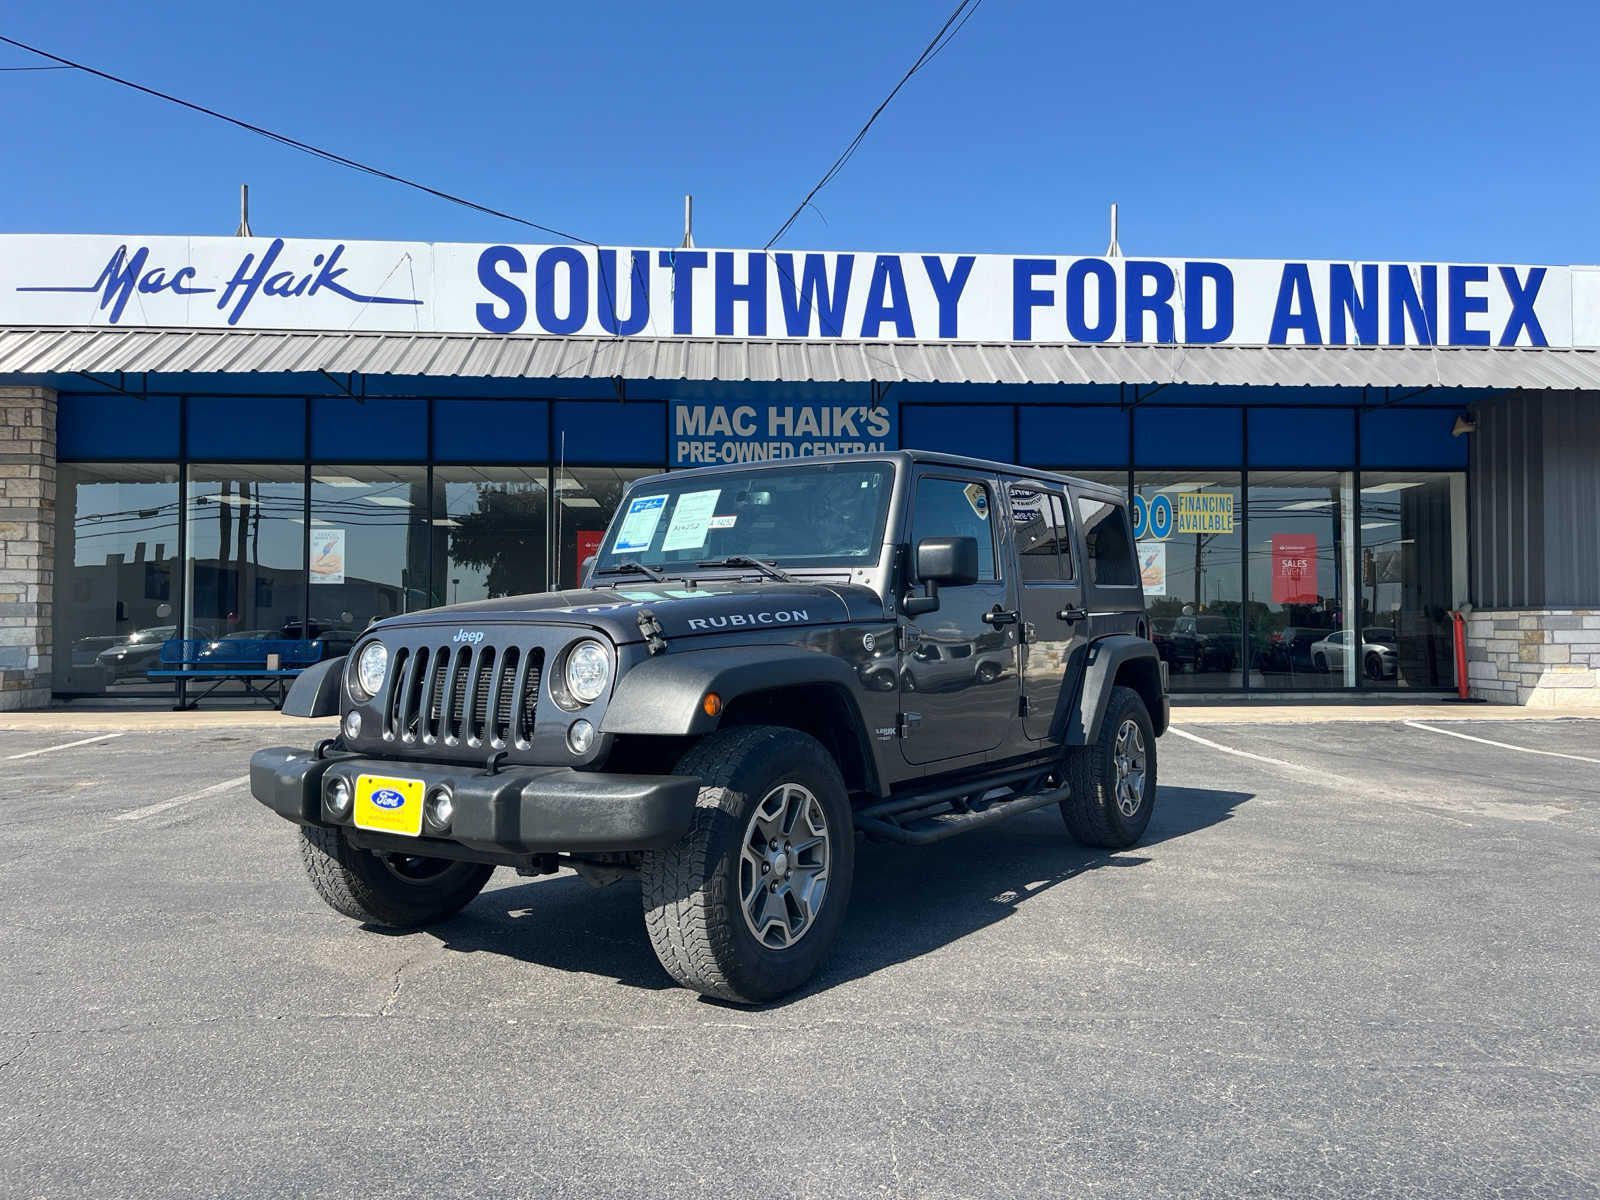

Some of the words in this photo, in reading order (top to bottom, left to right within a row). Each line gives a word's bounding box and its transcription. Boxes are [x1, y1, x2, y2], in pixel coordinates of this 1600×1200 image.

[16, 244, 216, 324] Mac
[217, 238, 424, 326] Haik
[476, 245, 977, 340] SOUTHWAY
[1013, 257, 1235, 344] FORD
[1268, 263, 1550, 347] ANNEX
[676, 405, 757, 437] MAC
[768, 406, 891, 438] HAIK'S
[677, 441, 794, 463] PRE-OWNED
[1179, 495, 1232, 512] FINANCING
[1179, 513, 1233, 531] AVAILABLE
[1281, 559, 1308, 568] SALES
[687, 609, 809, 631] RUBICON
[453, 628, 484, 643] Jeep
[375, 790, 401, 807] Ford
